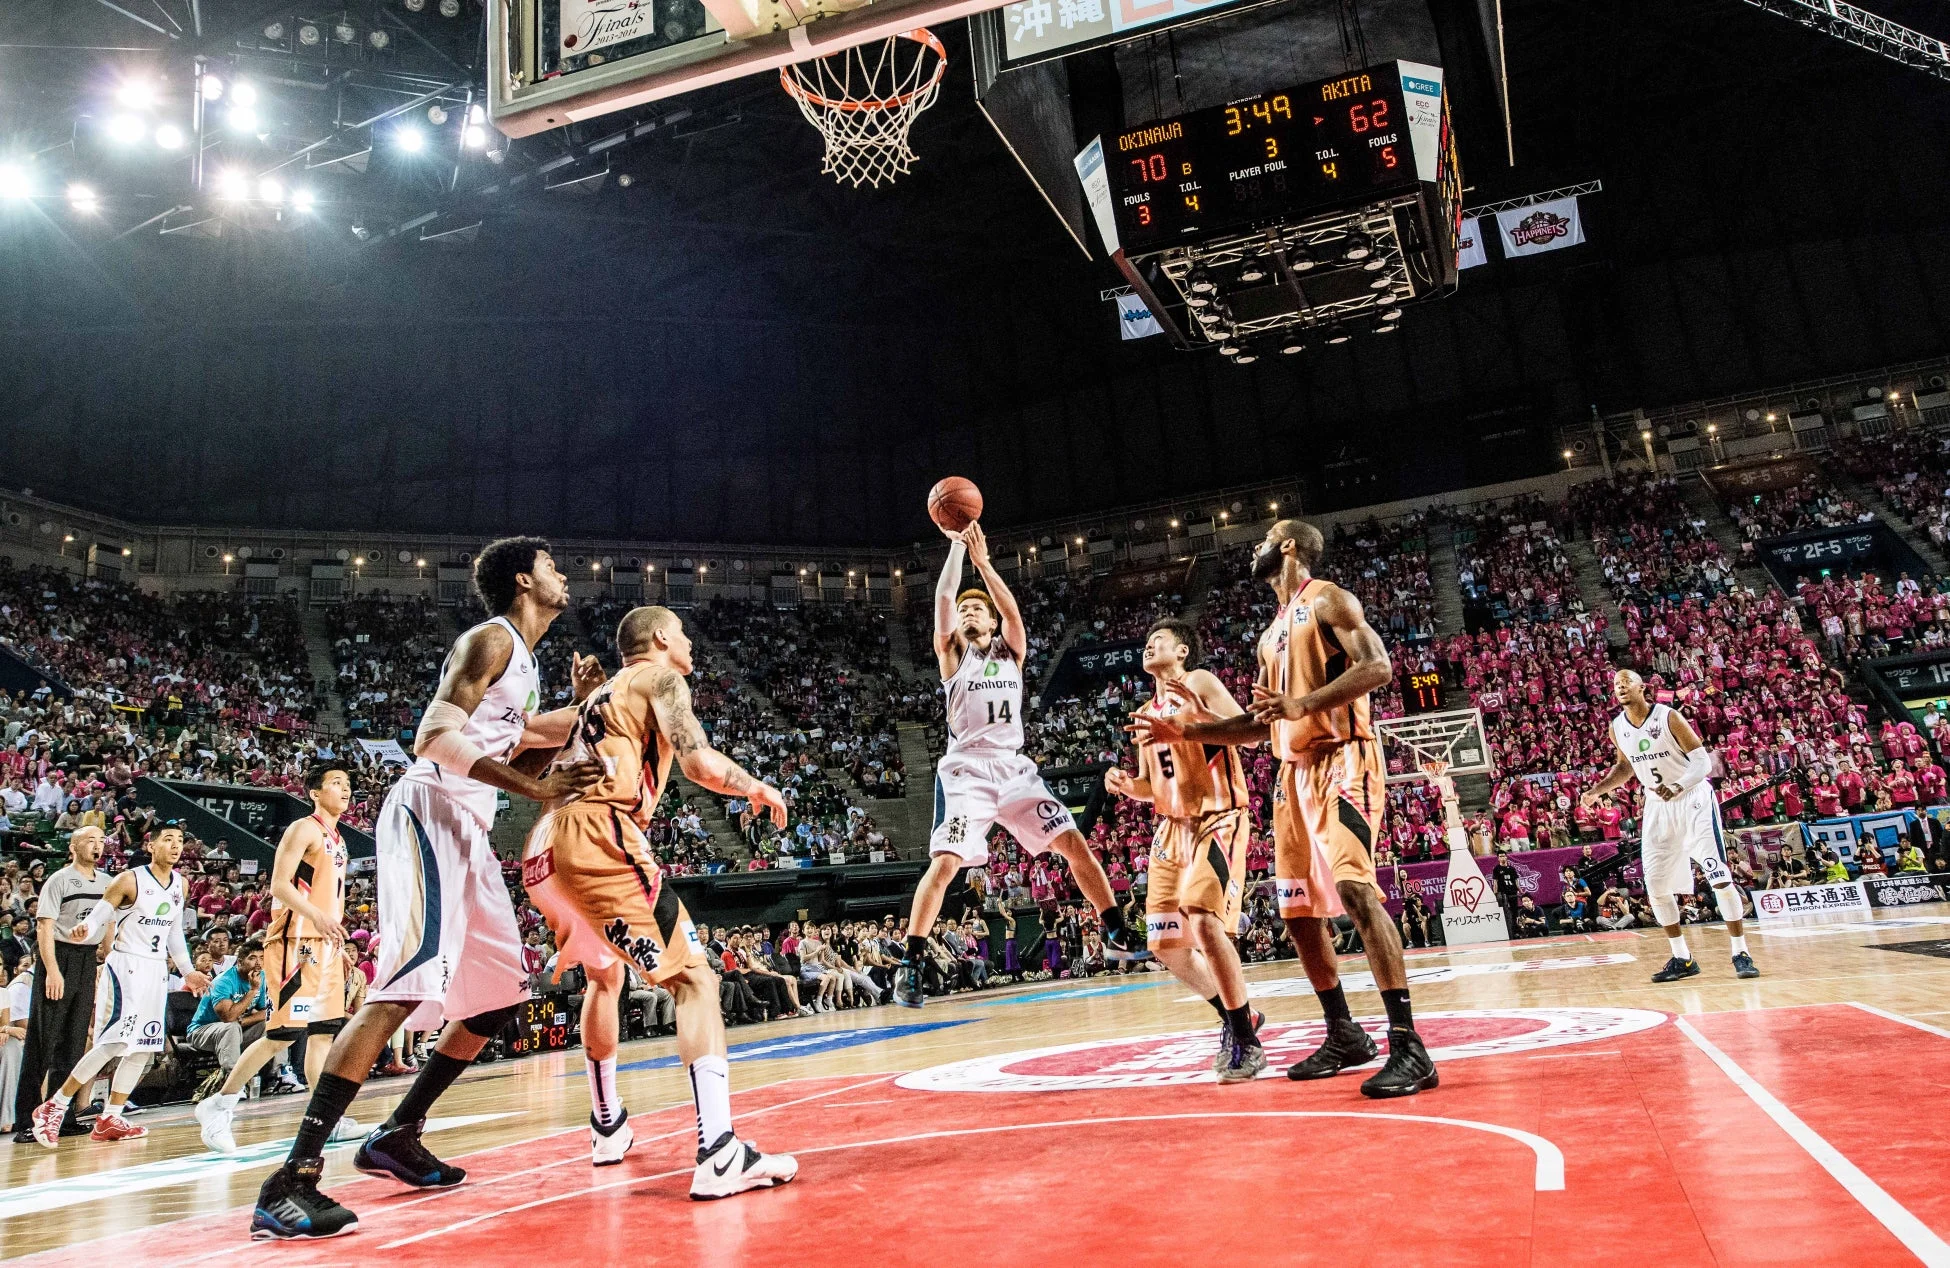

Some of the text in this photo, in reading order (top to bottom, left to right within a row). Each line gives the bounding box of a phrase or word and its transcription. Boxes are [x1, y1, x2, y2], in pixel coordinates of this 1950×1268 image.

[571, 4, 646, 52] Finals
[1322, 74, 1372, 101] AKITA
[1415, 83, 1434, 93] GREE
[1225, 95, 1292, 136] 3:49
[1349, 99, 1388, 133] 62
[1119, 121, 1183, 151] OKINAWA
[1368, 133, 1398, 148] FOULS
[1265, 137, 1278, 158] 3
[1315, 148, 1339, 161] T.O.L.
[1382, 146, 1397, 168] 5
[1131, 154, 1167, 182] 70
[1229, 160, 1288, 182] PLAYER FOUL
[1323, 162, 1337, 179] 4
[1179, 181, 1202, 193] T.O.L.
[1123, 192, 1151, 206] FOULS
[1185, 195, 1199, 211] 4
[1138, 205, 1151, 225] 3
[1803, 541, 1842, 560] 2F-5
[1103, 651, 1133, 667] 2F-6
[967, 678, 1018, 692] Zenhoren
[1411, 673, 1439, 689] 3:49
[1899, 677, 1911, 687] E
[1419, 688, 1438, 708] 11
[985, 700, 1013, 725] 14
[1157, 748, 1174, 779] 5
[1650, 767, 1663, 784] 5
[240, 801, 267, 811] セクション
[1560, 798, 1568, 806] 5
[248, 812, 257, 824] F
[1406, 881, 1421, 894] GO
[1450, 887, 1476, 906] IRIS
[1785, 886, 1862, 907] 日本通運
[1824, 901, 1863, 909] EXPRESS
[1445, 912, 1500, 927] アイリスオーヤマ
[533, 1030, 540, 1049] 3
[549, 1026, 565, 1047] 62
